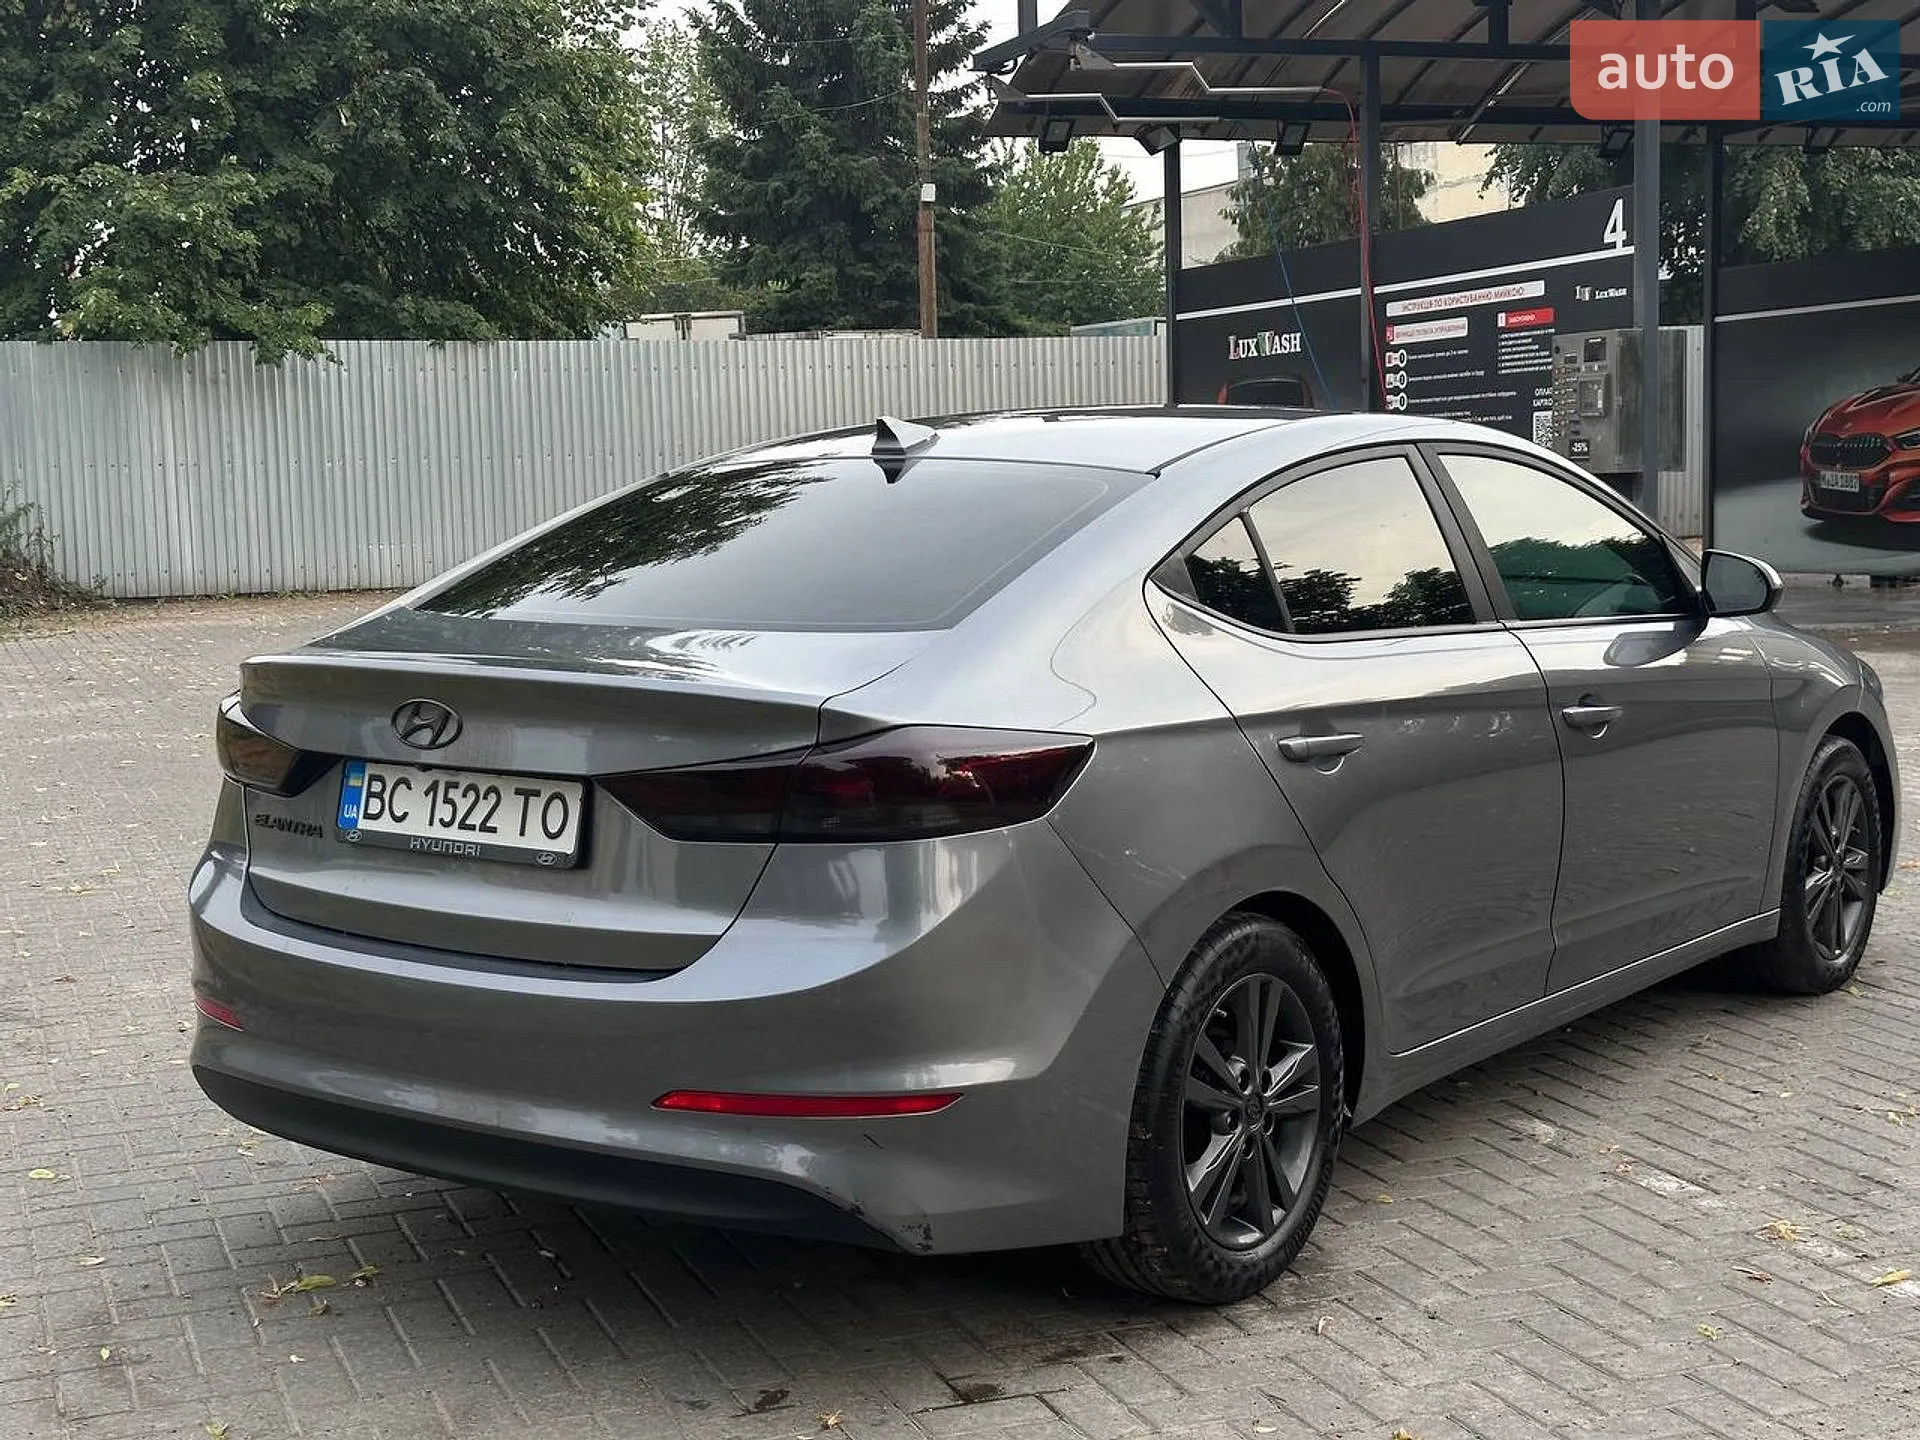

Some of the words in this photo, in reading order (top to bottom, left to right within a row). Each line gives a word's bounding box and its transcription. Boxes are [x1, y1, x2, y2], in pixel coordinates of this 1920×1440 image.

[1603, 197, 1627, 251] 4
[343, 804, 358, 820] UA
[362, 774, 412, 824] BC
[423, 779, 503, 834] 1522
[514, 787, 570, 841] TO
[254, 813, 324, 840] ELANTRA
[410, 837, 482, 857] HYUNDAI
